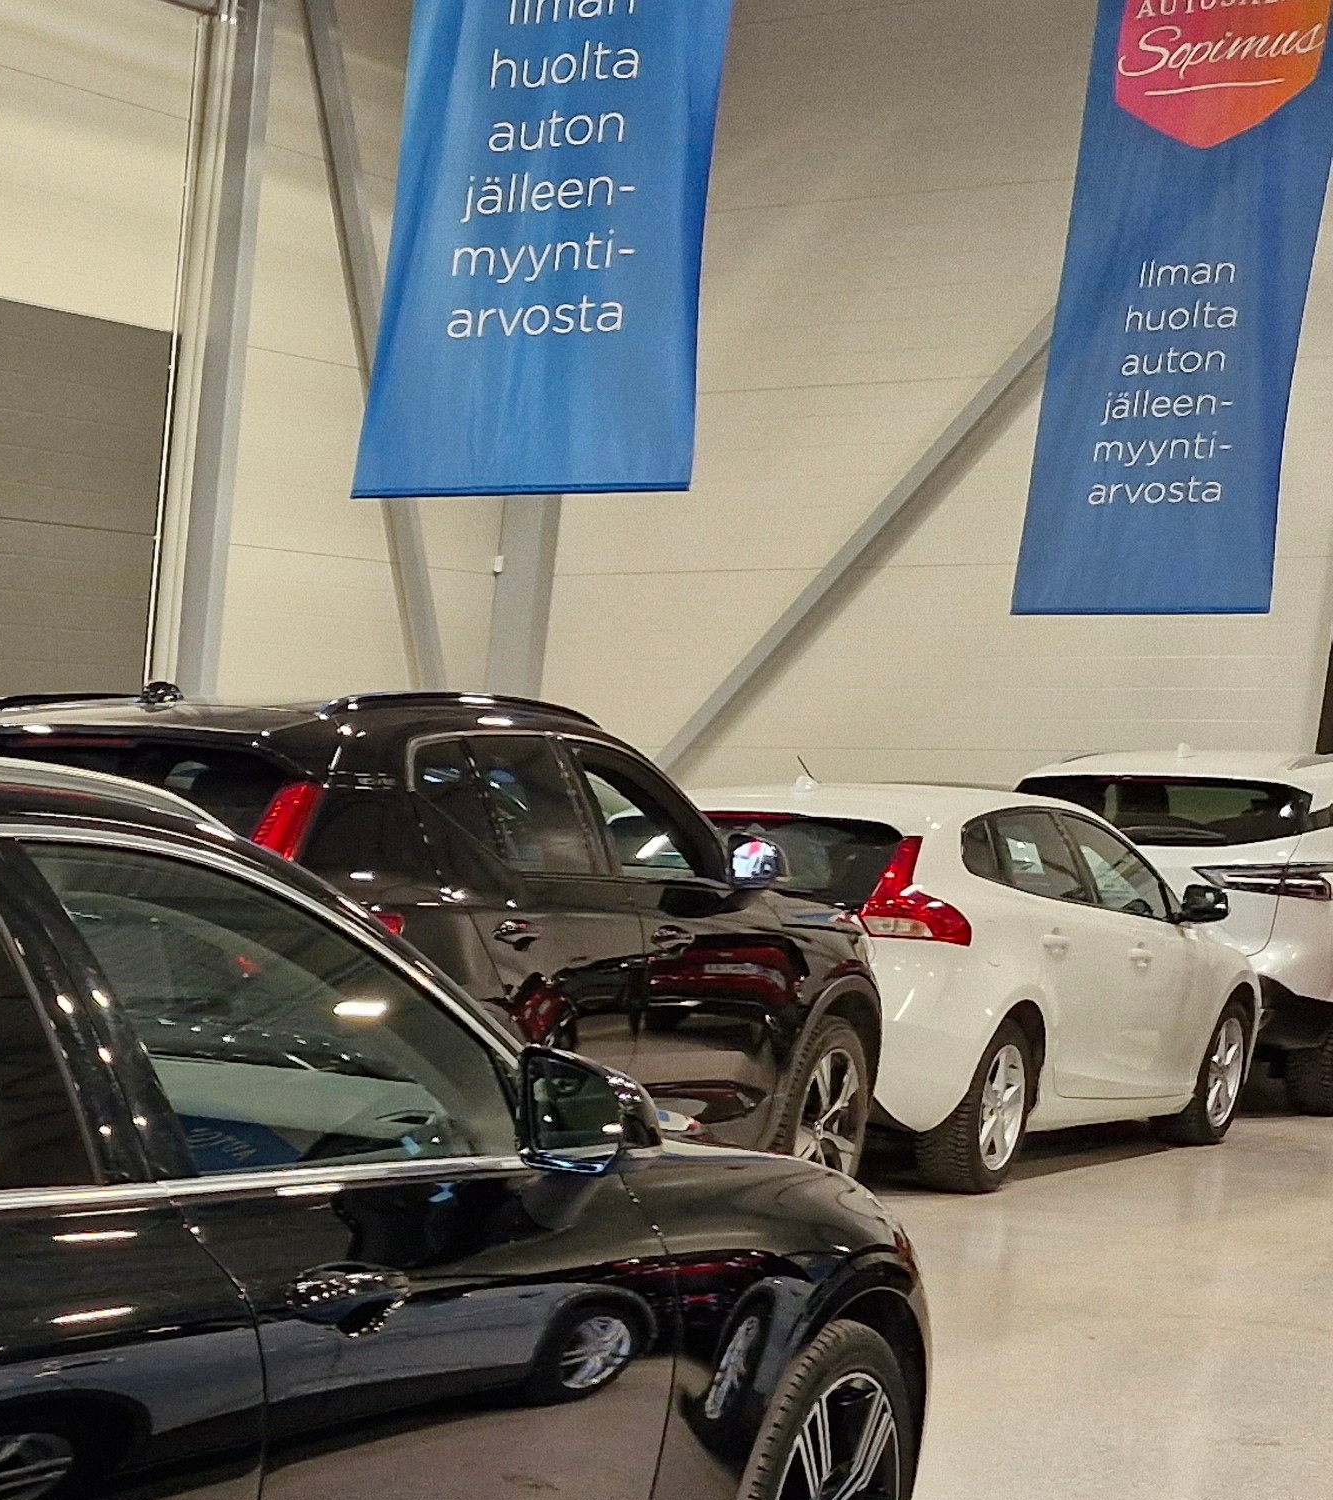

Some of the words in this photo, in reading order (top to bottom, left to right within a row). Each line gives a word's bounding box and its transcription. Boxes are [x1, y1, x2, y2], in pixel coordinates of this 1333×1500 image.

[490, 40, 641, 89] huolta
[1117, 23, 1325, 80] Sopimus
[488, 109, 625, 152] auton
[460, 171, 636, 223] jälleen-
[451, 229, 636, 284] myynti-
[1139, 258, 1236, 288] Ilman
[447, 295, 624, 339] arvosta
[1124, 300, 1239, 333] huolta
[1121, 347, 1226, 376] auton
[1100, 389, 1234, 426] jälleen-
[1093, 430, 1233, 467] myynti-
[1088, 476, 1222, 505] arvosta
